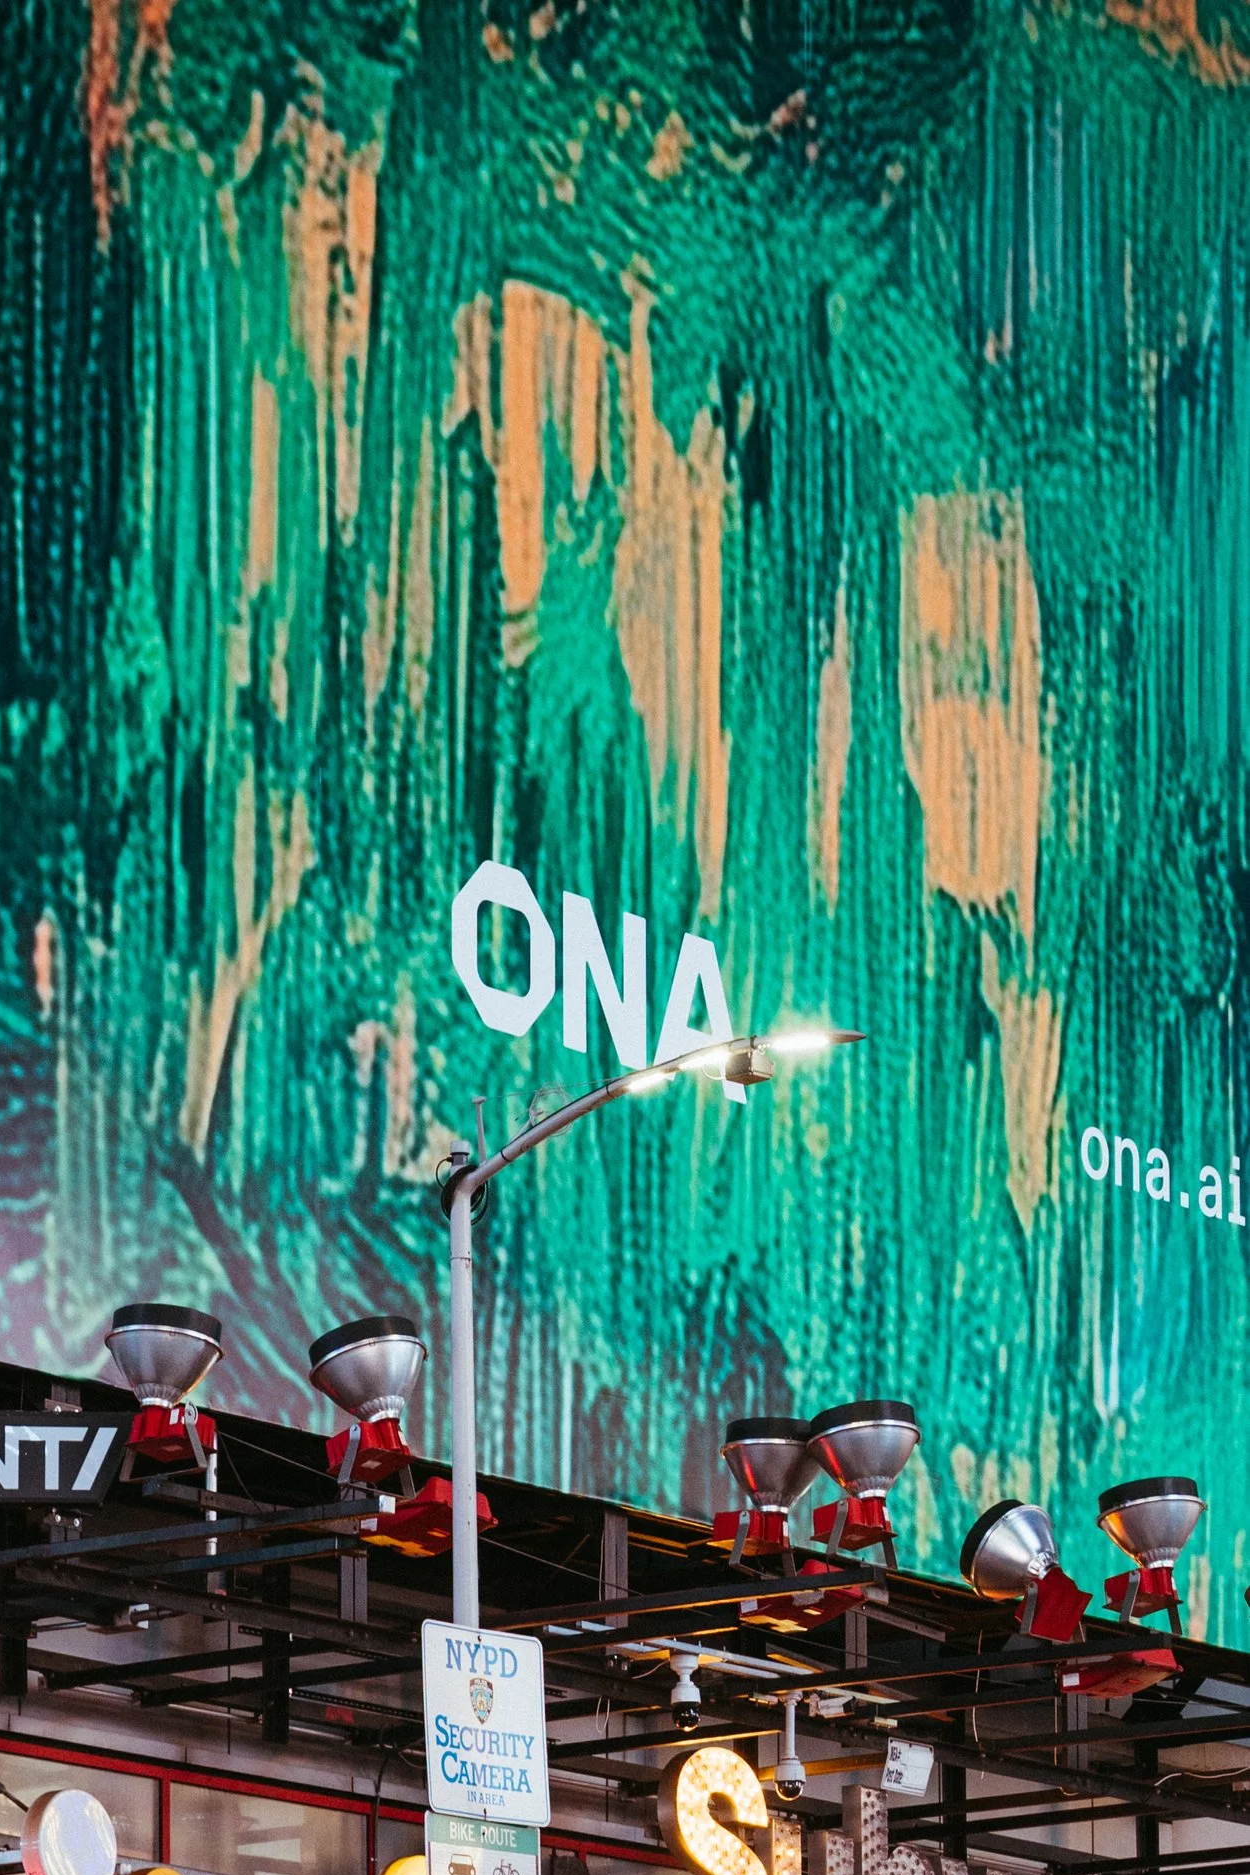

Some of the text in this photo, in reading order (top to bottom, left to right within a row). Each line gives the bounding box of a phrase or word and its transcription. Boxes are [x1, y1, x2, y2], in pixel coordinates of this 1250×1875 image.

[451, 859, 748, 1105] ONA
[1080, 1126, 1248, 1228] ona.ai
[445, 1638, 518, 1679] NYPD
[435, 1714, 535, 1760] SECURITY
[441, 1751, 533, 1793] CAMERA
[467, 1790, 506, 1807] IN AREA
[450, 1822, 517, 1847] BIKE ROUTE
